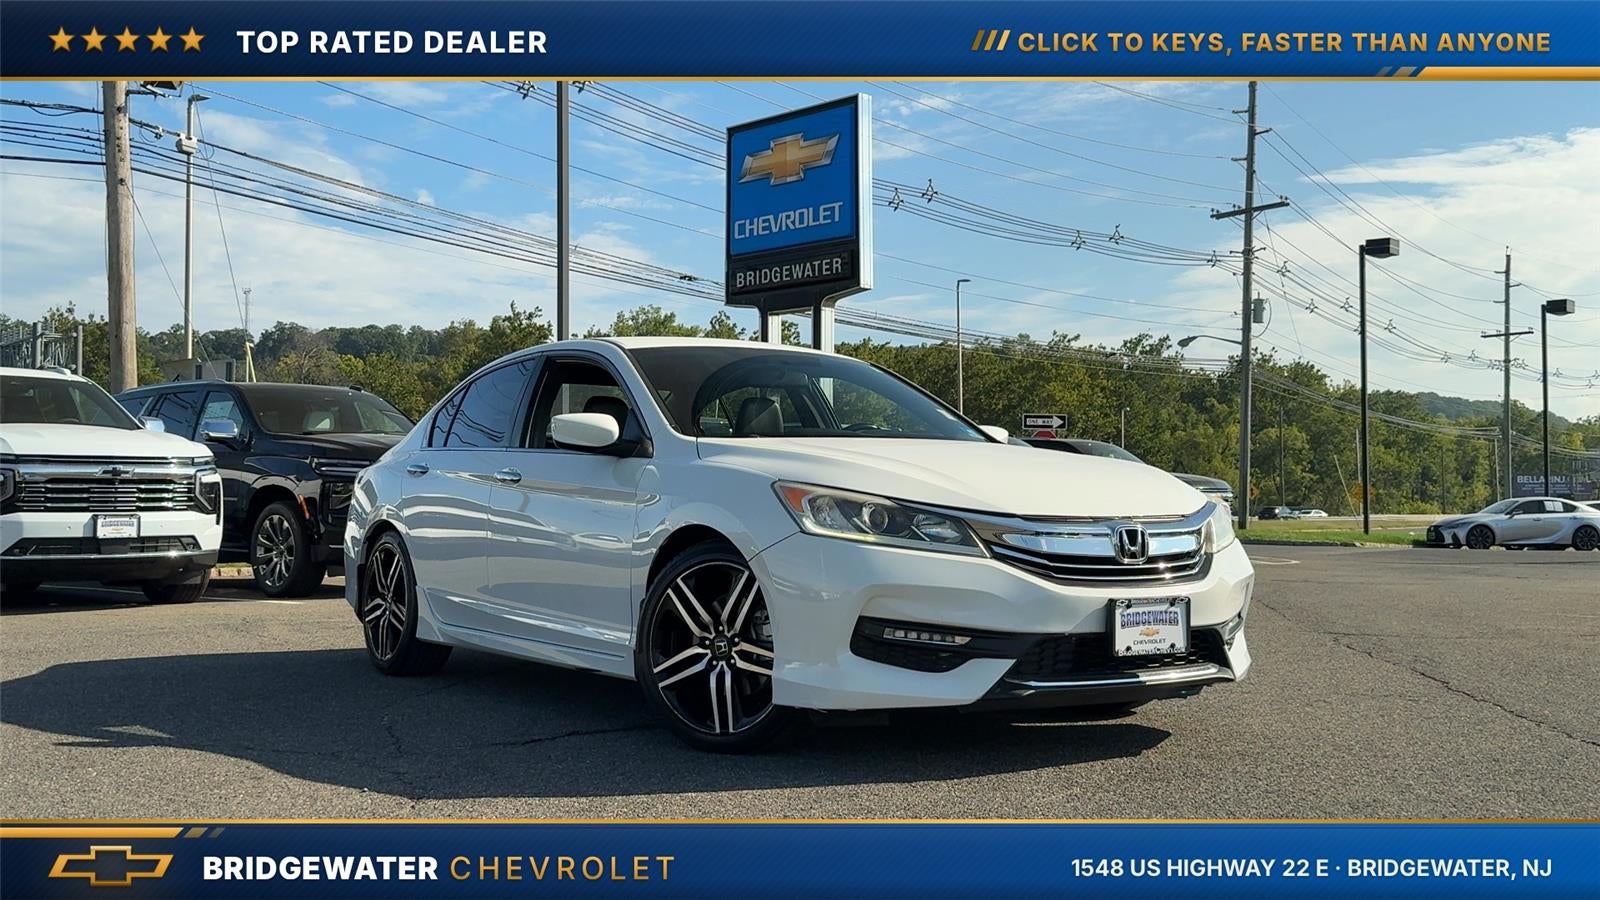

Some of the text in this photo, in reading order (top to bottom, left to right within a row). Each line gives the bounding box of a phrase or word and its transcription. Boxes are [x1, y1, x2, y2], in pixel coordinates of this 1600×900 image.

[734, 201, 843, 239] CHEVROLET
[736, 258, 842, 288] BRIDGEWATER
[1120, 610, 1179, 628] BRIDGEWATER
